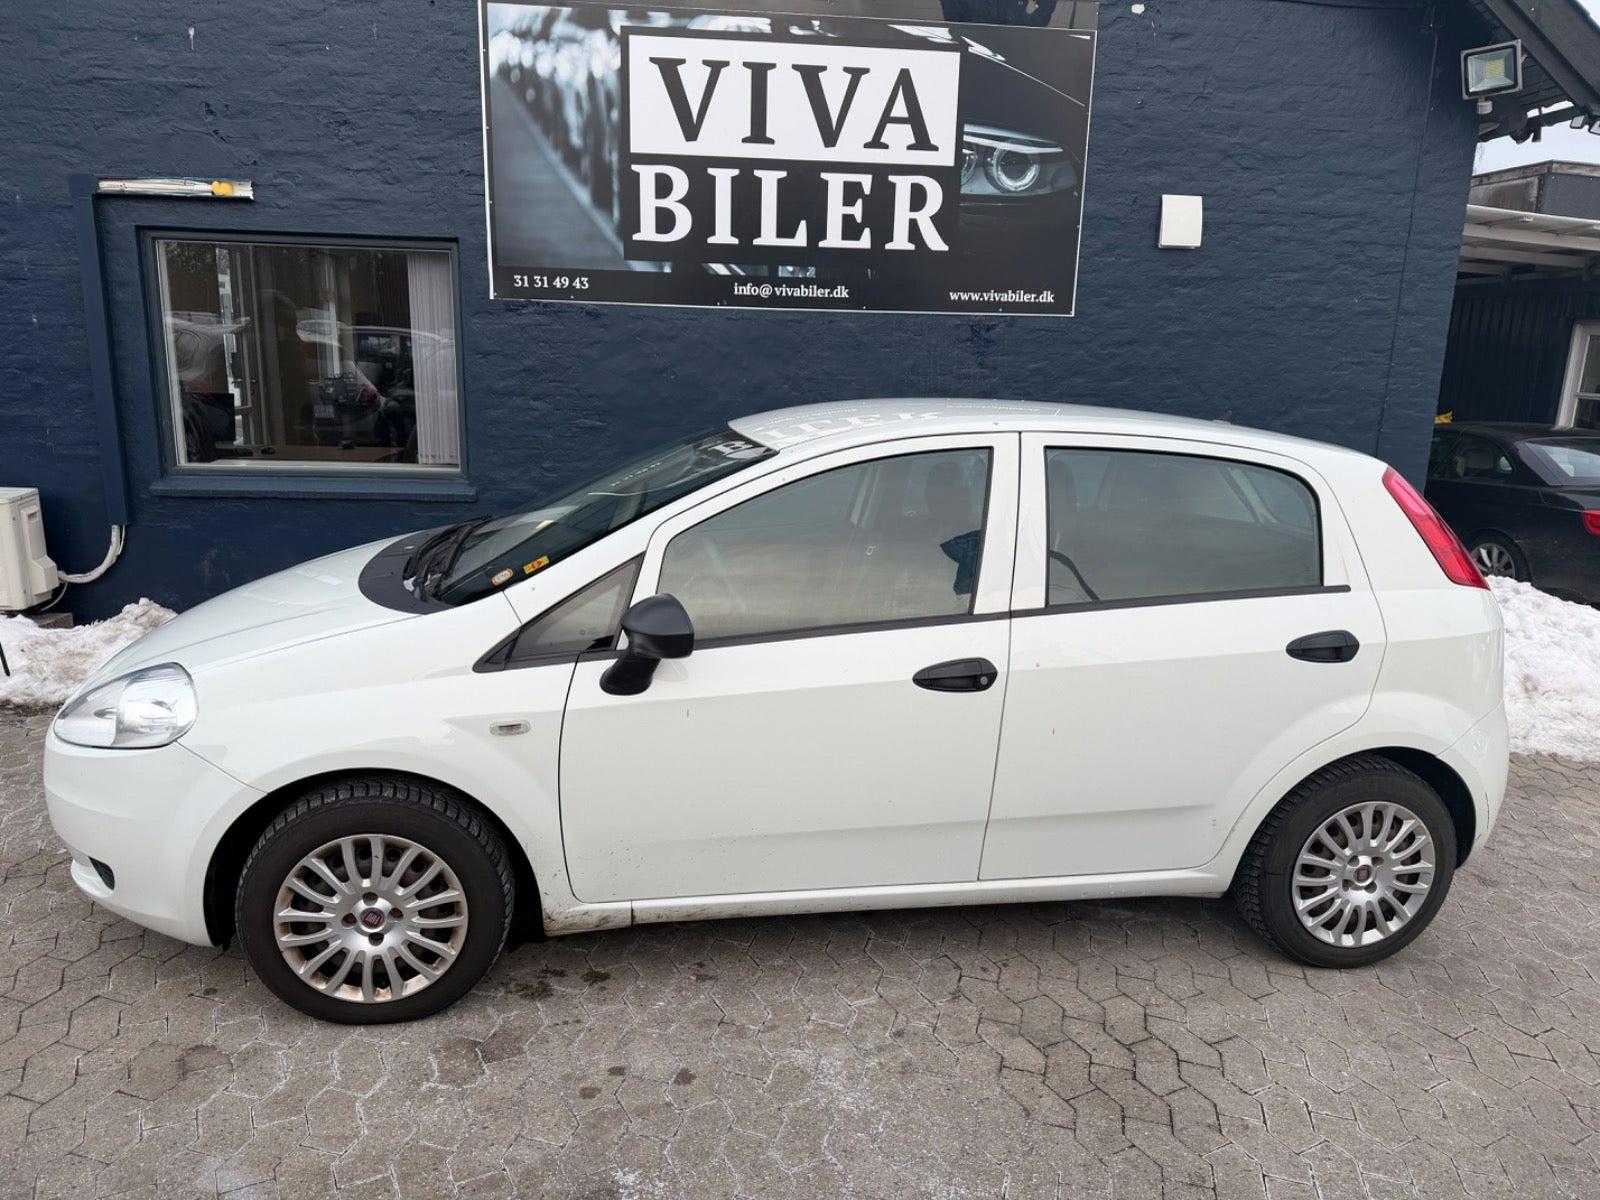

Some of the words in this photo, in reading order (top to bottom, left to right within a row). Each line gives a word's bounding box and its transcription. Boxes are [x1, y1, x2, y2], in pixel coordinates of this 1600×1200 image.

[648, 56, 940, 153] VIVA
[630, 163, 950, 252] BILER
[513, 274, 530, 288] 31
[533, 275, 549, 289] 31
[552, 276, 570, 290] 49
[572, 277, 589, 290] 43
[733, 282, 850, 299] info@vivabiler.dk
[949, 289, 1055, 303] www.vivabiler.dk
